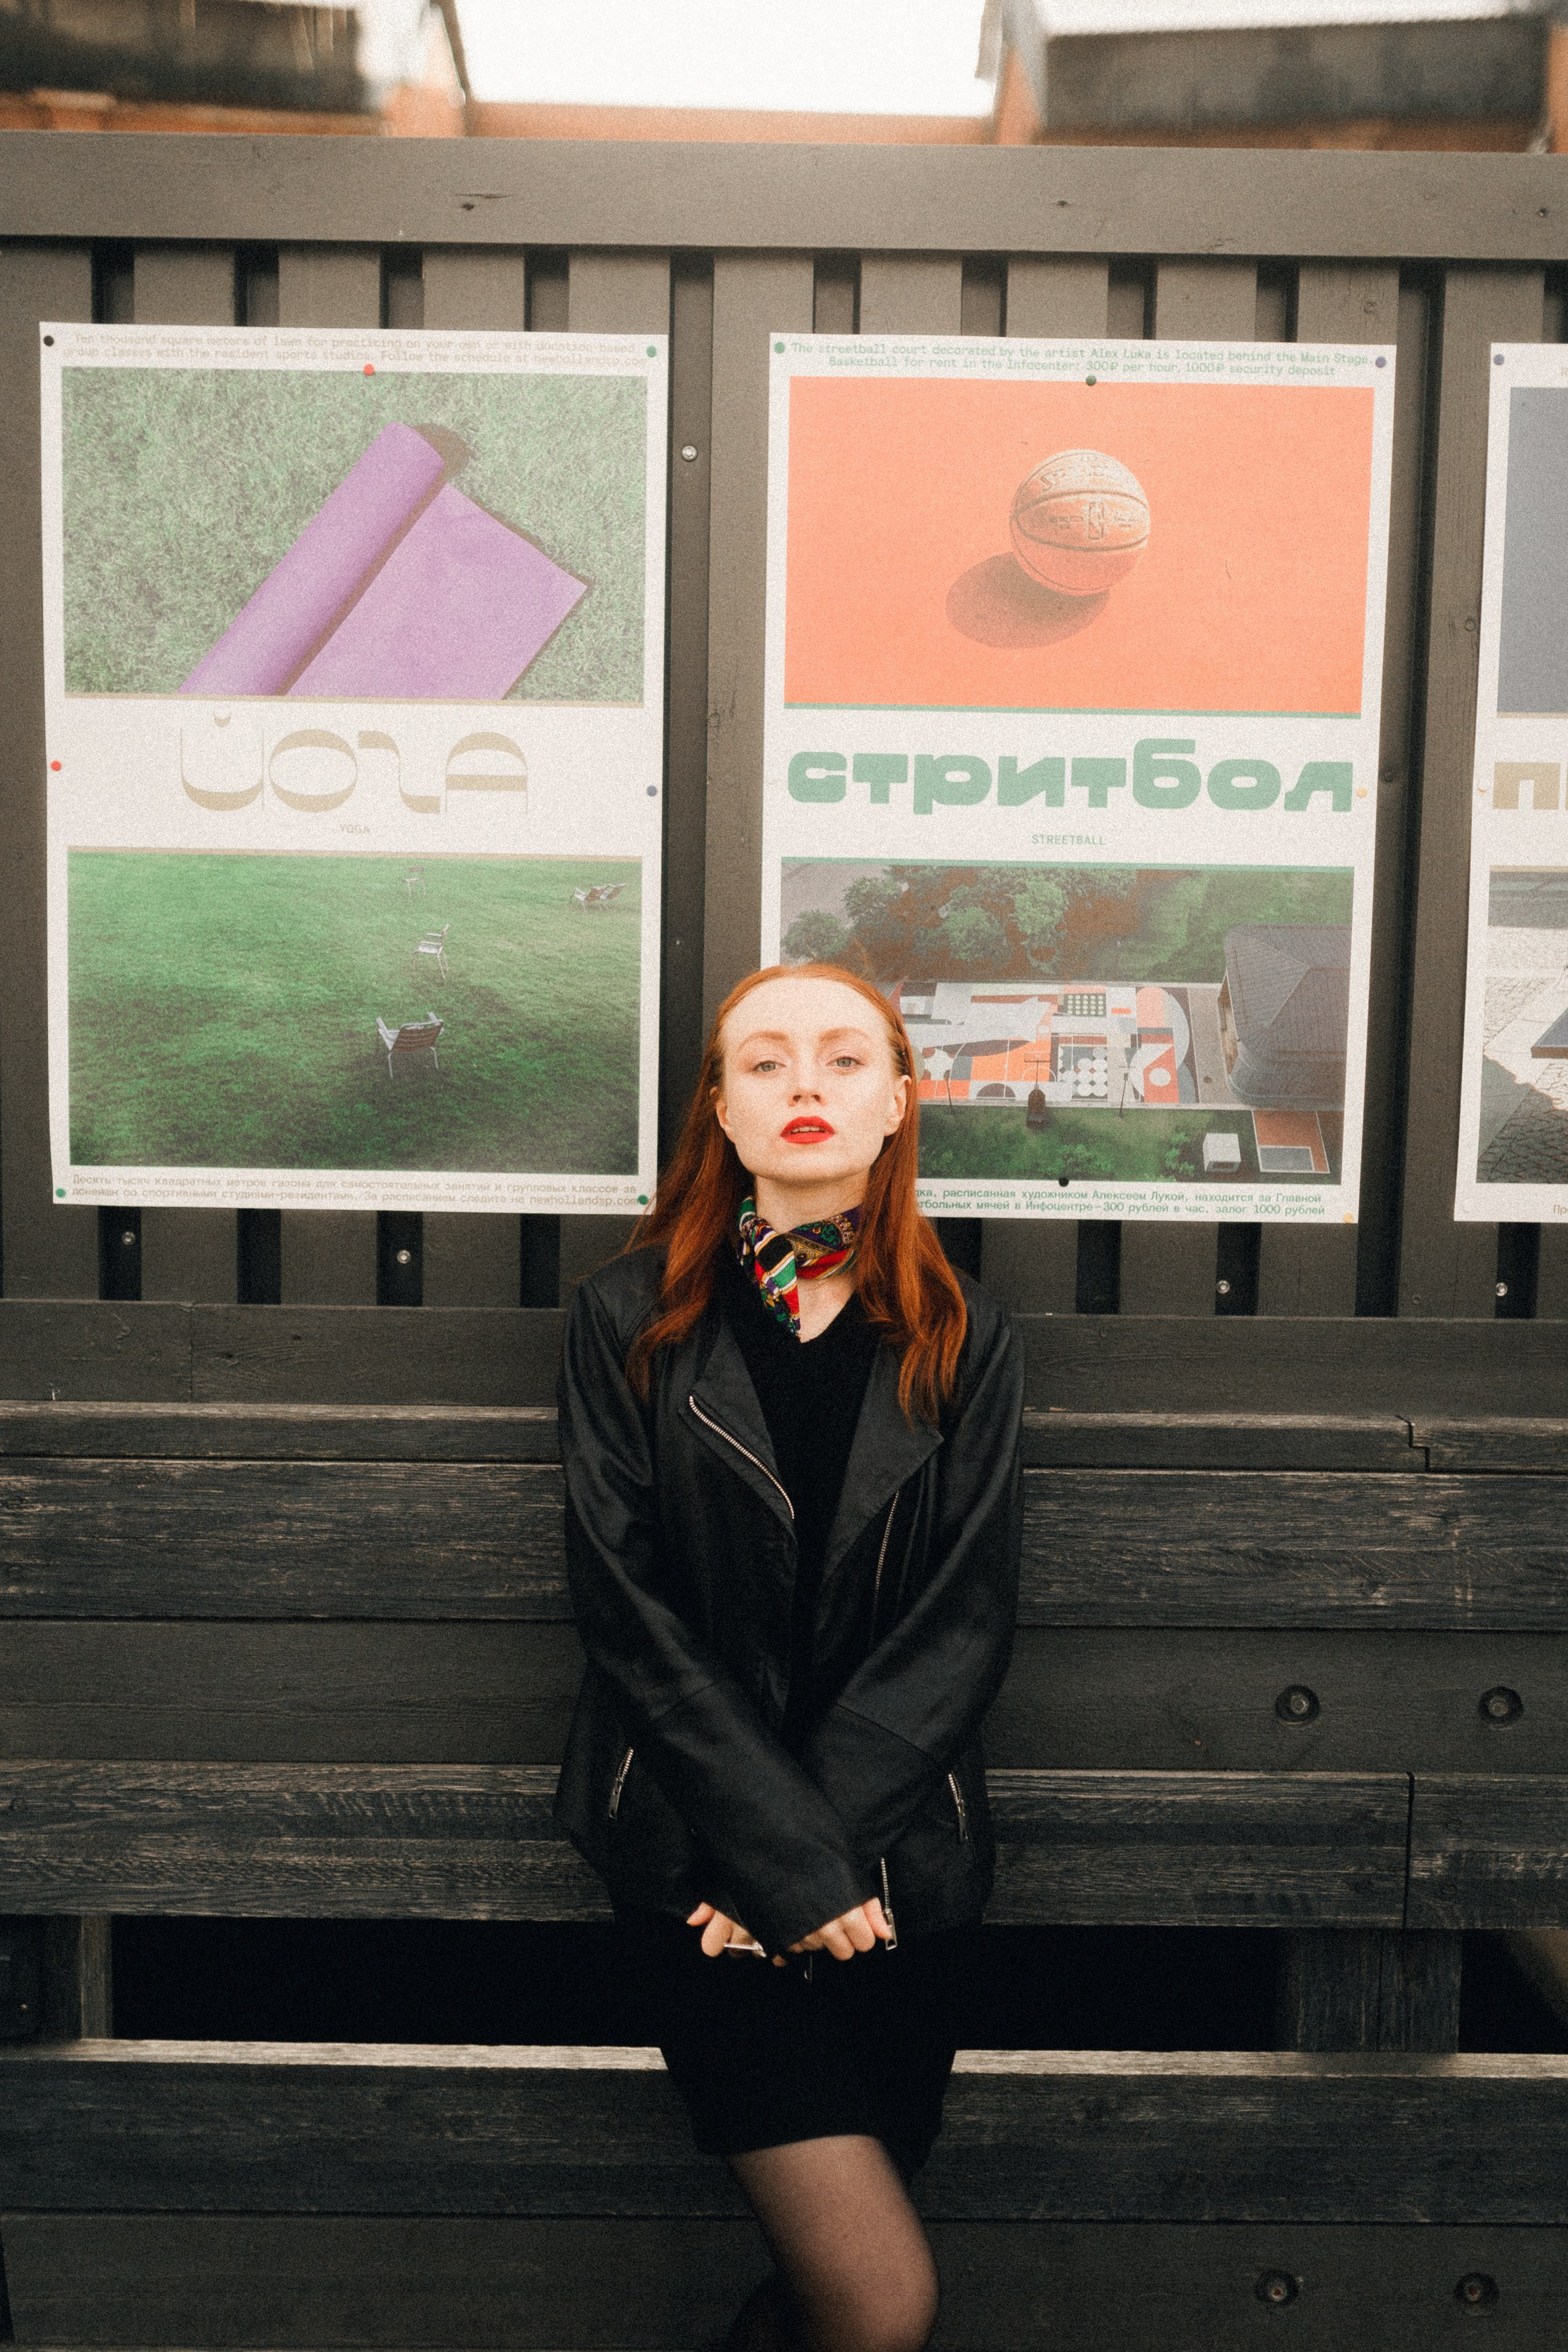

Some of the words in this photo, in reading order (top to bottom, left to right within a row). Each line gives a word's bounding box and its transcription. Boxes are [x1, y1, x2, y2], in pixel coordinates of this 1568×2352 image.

[160, 336, 203, 348] square
[206, 335, 249, 346] meters
[254, 336, 267, 346] of
[308, 338, 327, 347] for
[426, 340, 452, 352] your
[458, 341, 481, 350] own
[505, 340, 531, 351] with
[157, 347, 184, 357] with
[189, 348, 210, 358] the
[276, 349, 317, 362] sports
[380, 351, 422, 362] Follow
[428, 351, 449, 362] the
[454, 352, 510, 363] schedule
[515, 354, 528, 363] at
[790, 342, 813, 353] The
[818, 342, 886, 354] streetball
[891, 343, 927, 354] court
[931, 344, 995, 356] decorated
[999, 346, 1014, 359] by
[1018, 346, 1040, 356] the
[1044, 346, 1085, 357] artist
[1090, 347, 1118, 358] Alex
[1122, 348, 1151, 359] Luka
[1156, 348, 1169, 359] is
[1176, 348, 1224, 360] located
[1228, 349, 1271, 361] behind
[1275, 350, 1297, 361] the
[1300, 351, 1329, 362] Main
[828, 356, 897, 367] Basketball
[904, 356, 924, 367] for
[928, 357, 957, 368] rent
[963, 358, 976, 369] in
[981, 358, 1002, 369] the
[1006, 359, 1080, 370] Infocenter:
[1122, 363, 1144, 375] per
[1228, 362, 1283, 377] security
[1287, 364, 1335, 378] deposit
[339, 822, 371, 835] YOGA
[1031, 833, 1106, 846] STREETBALL
[72, 1174, 110, 1184] Десять
[154, 1177, 221, 1188] квадратных
[226, 1179, 266, 1188] метров
[315, 1180, 335, 1190] для
[340, 1181, 440, 1190] самостоятельных
[507, 1184, 566, 1194] групповых
[141, 1189, 217, 1200] спортивными
[364, 1191, 377, 1201] За
[381, 1193, 455, 1204] расписанием
[460, 1195, 507, 1205] следите
[942, 1189, 1016, 1200] расписанная
[1021, 1191, 1087, 1201] художником
[1091, 1190, 1146, 1200] Алексеем
[1150, 1191, 1188, 1203] Лукой,
[1194, 1193, 1253, 1204] находится
[1275, 1193, 1321, 1203] Главной
[976, 1200, 1010, 1209] мячей
[1127, 1203, 1169, 1215] рублей
[1185, 1206, 1209, 1216] час,
[1254, 1205, 1281, 1214] 1000
[1284, 1206, 1325, 1218] рублей
